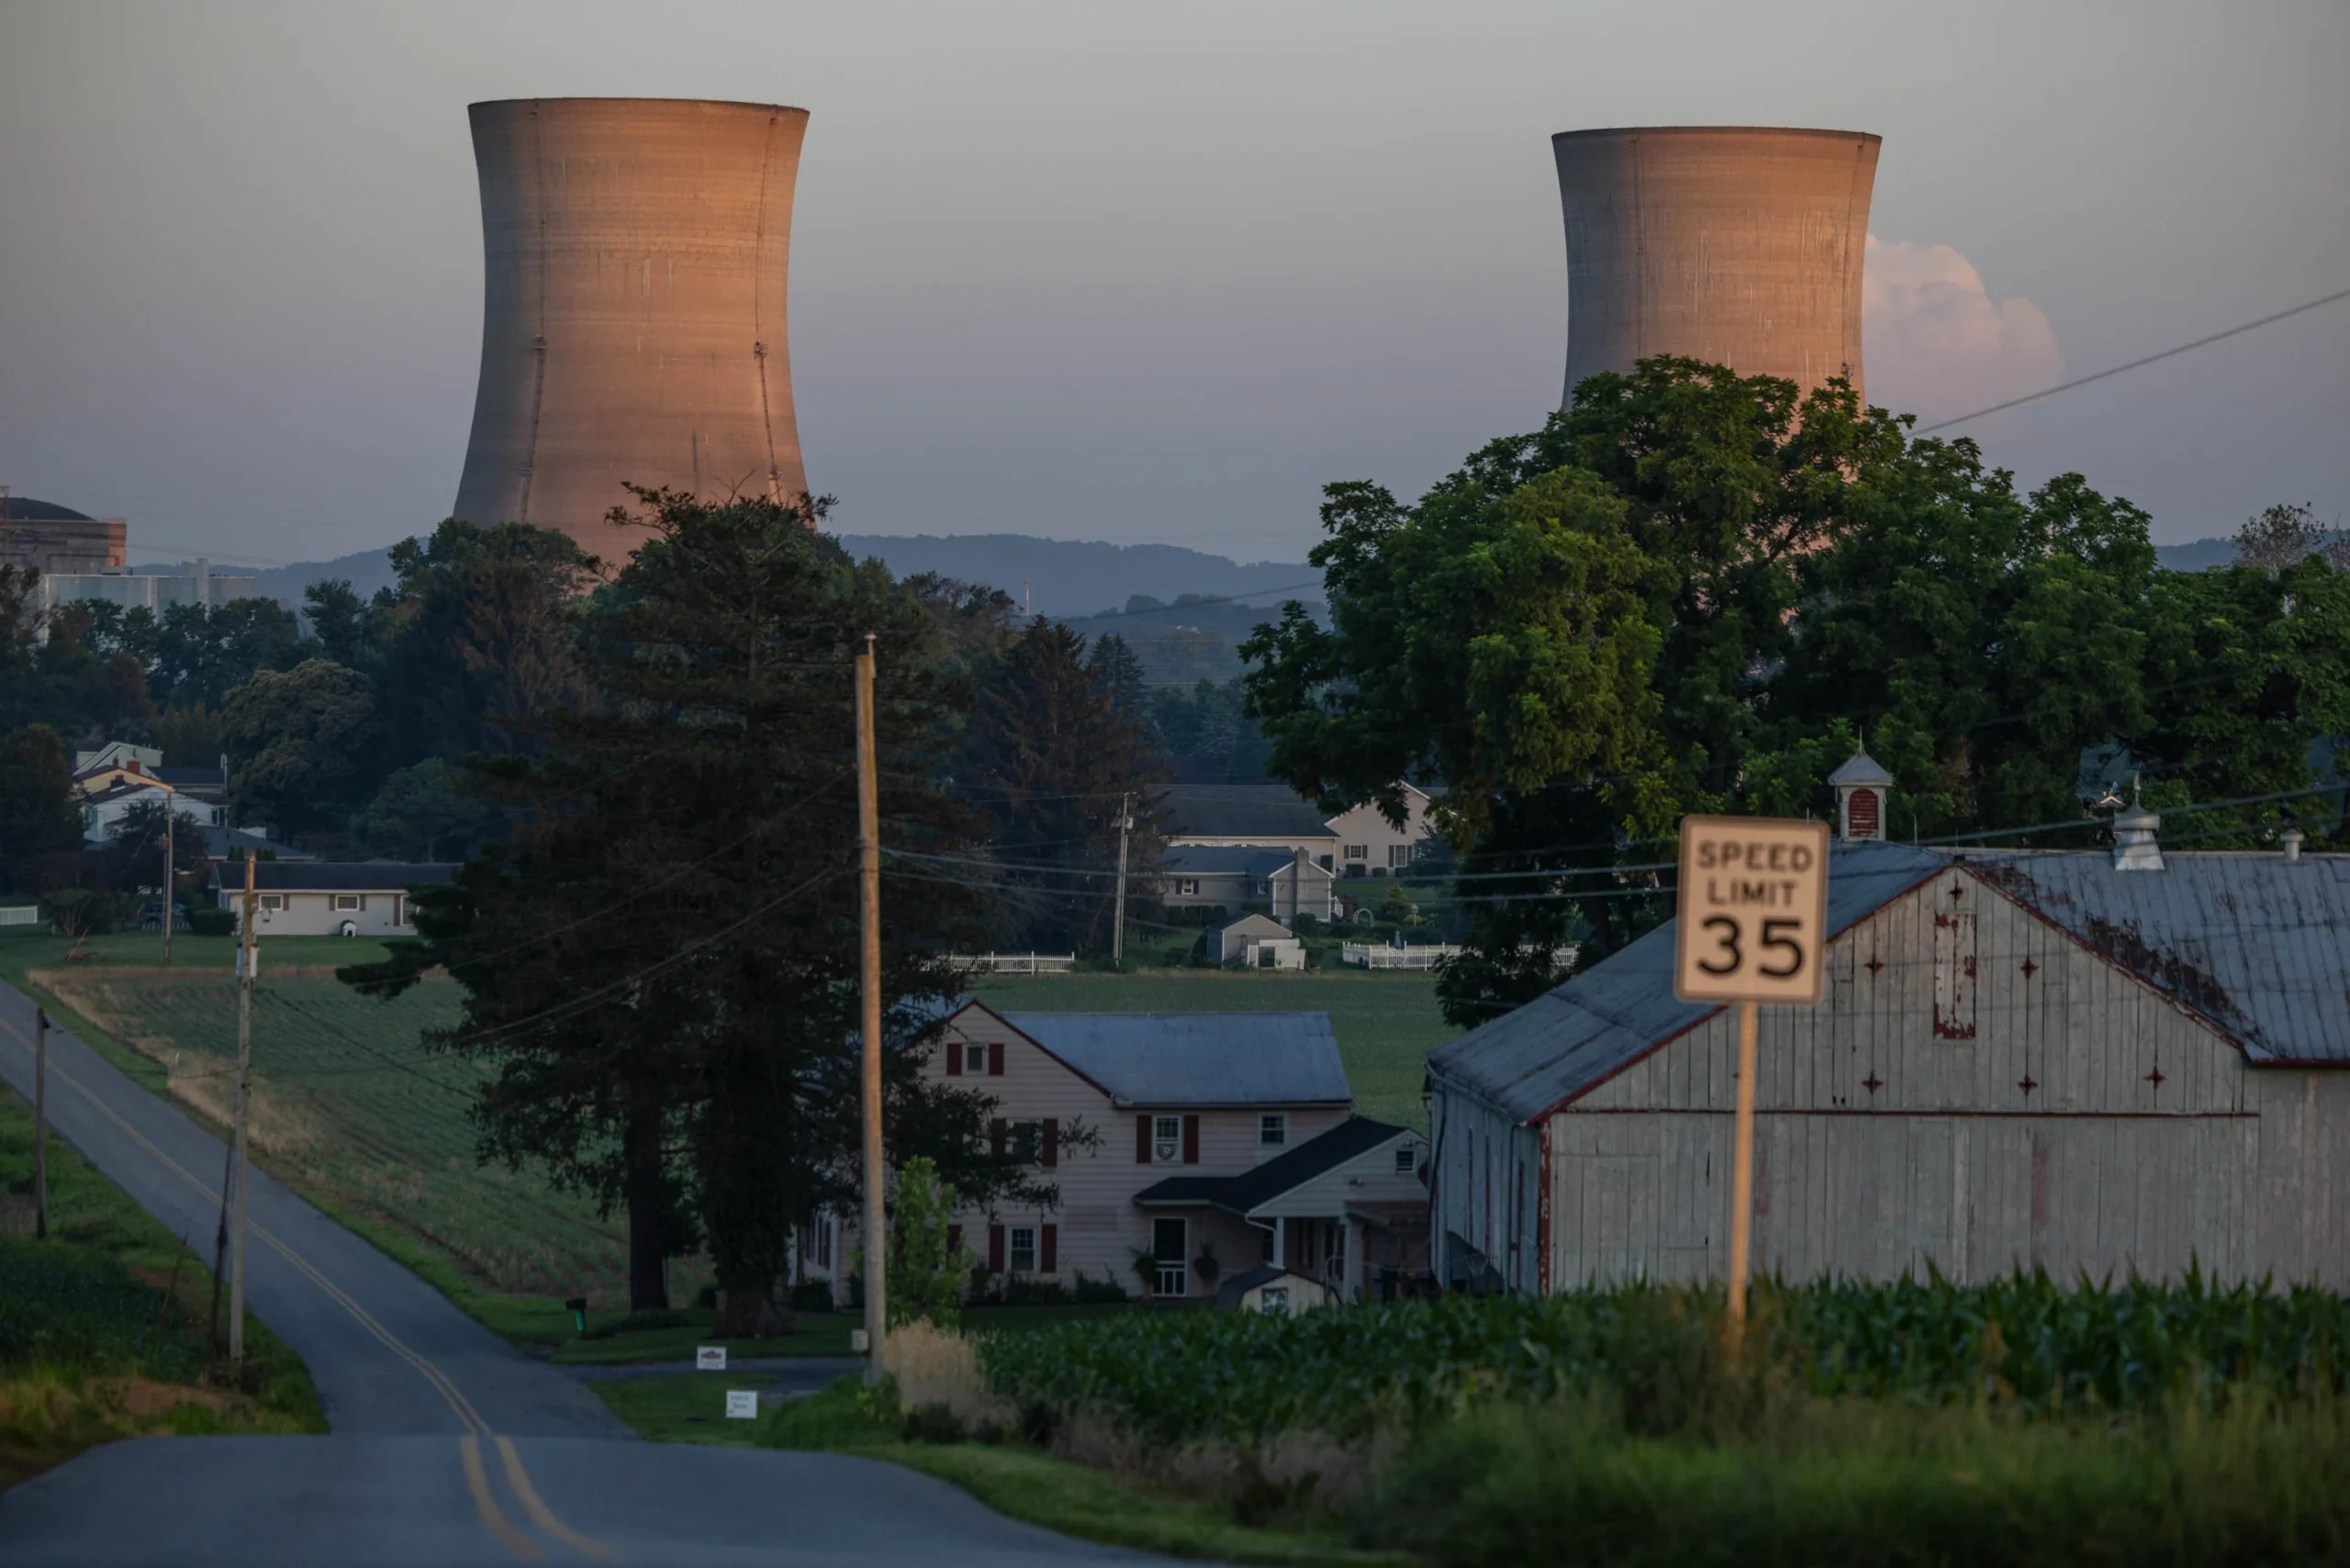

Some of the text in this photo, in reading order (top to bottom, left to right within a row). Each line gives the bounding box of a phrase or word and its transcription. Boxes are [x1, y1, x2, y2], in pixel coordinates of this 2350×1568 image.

[1698, 841, 1813, 872] SPEED
[1707, 879, 1796, 906] LIMIT
[1697, 916, 1803, 978] 35
